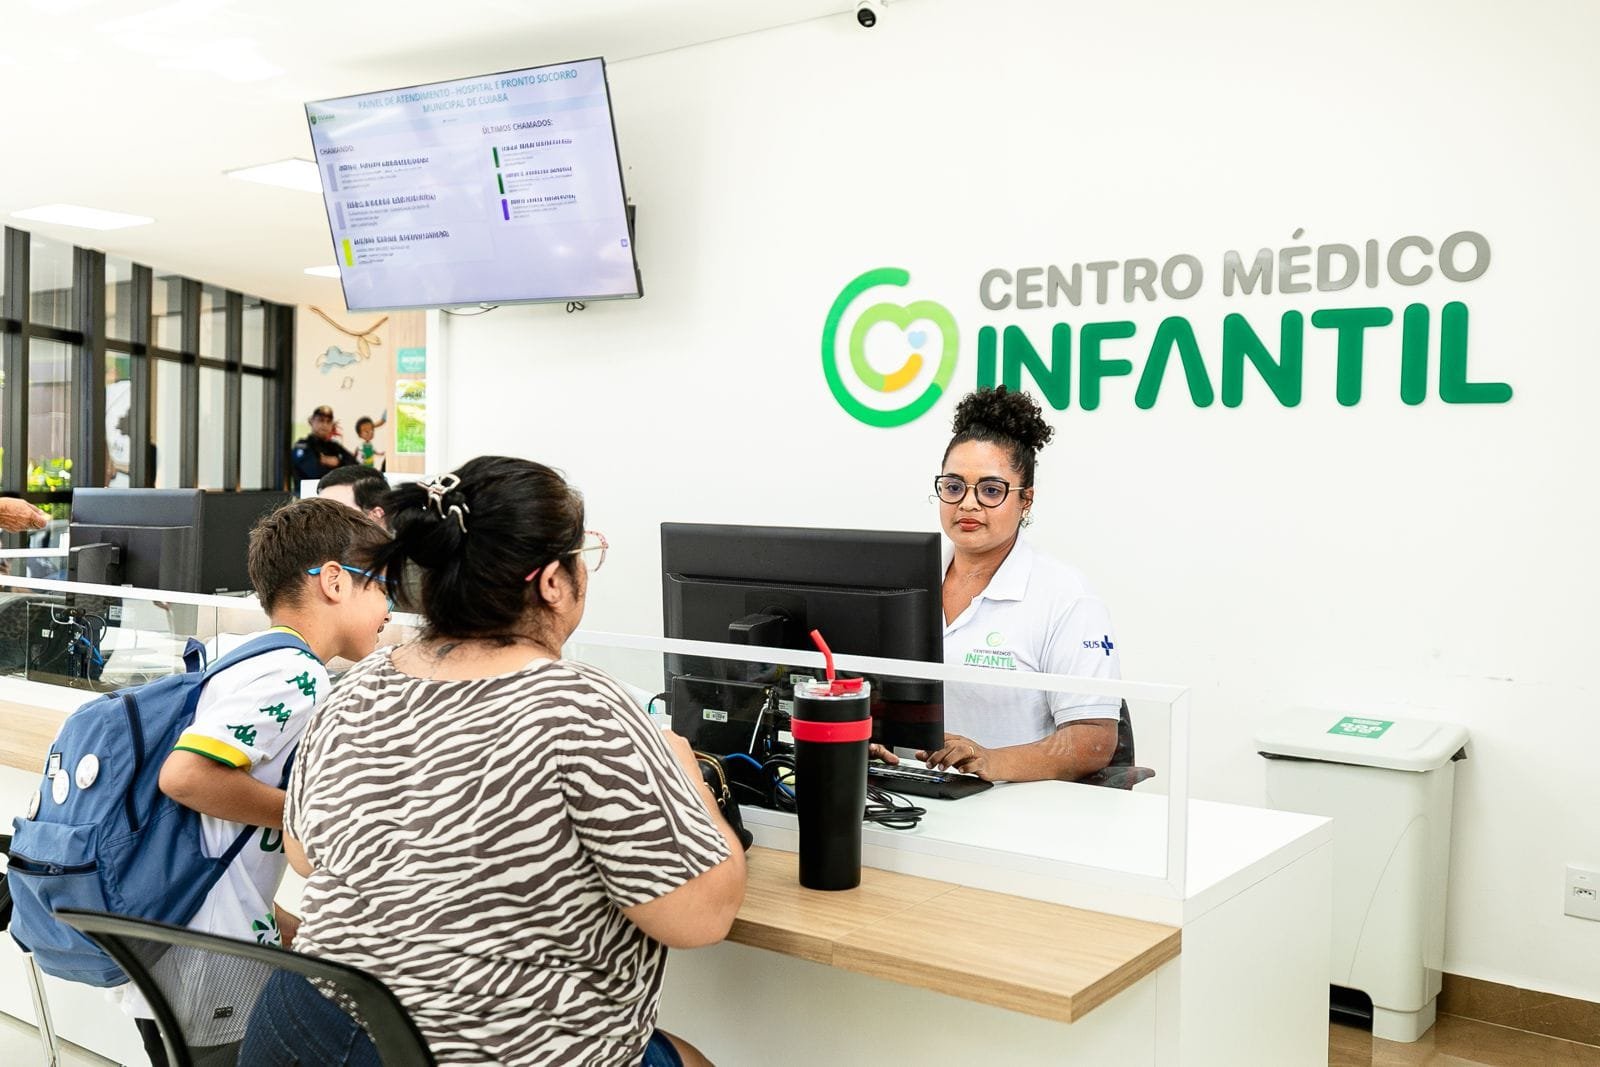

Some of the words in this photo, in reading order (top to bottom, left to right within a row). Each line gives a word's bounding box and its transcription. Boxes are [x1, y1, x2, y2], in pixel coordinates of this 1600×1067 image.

[358, 98, 383, 110] PAINEL
[396, 88, 450, 104] ATENDIMENTO
[456, 82, 493, 96] HOSPITAL
[500, 75, 535, 89] PRONTO
[537, 68, 578, 84] SOCORRO
[422, 96, 465, 113] MUNICIPAL
[467, 97, 478, 108] DE
[979, 253, 1203, 311] CENTRO
[1222, 227, 1492, 298] MÉDICO
[976, 300, 1515, 412] INFANTIL
[1083, 640, 1100, 649] SUS
[964, 652, 1017, 668] INFANTIL
